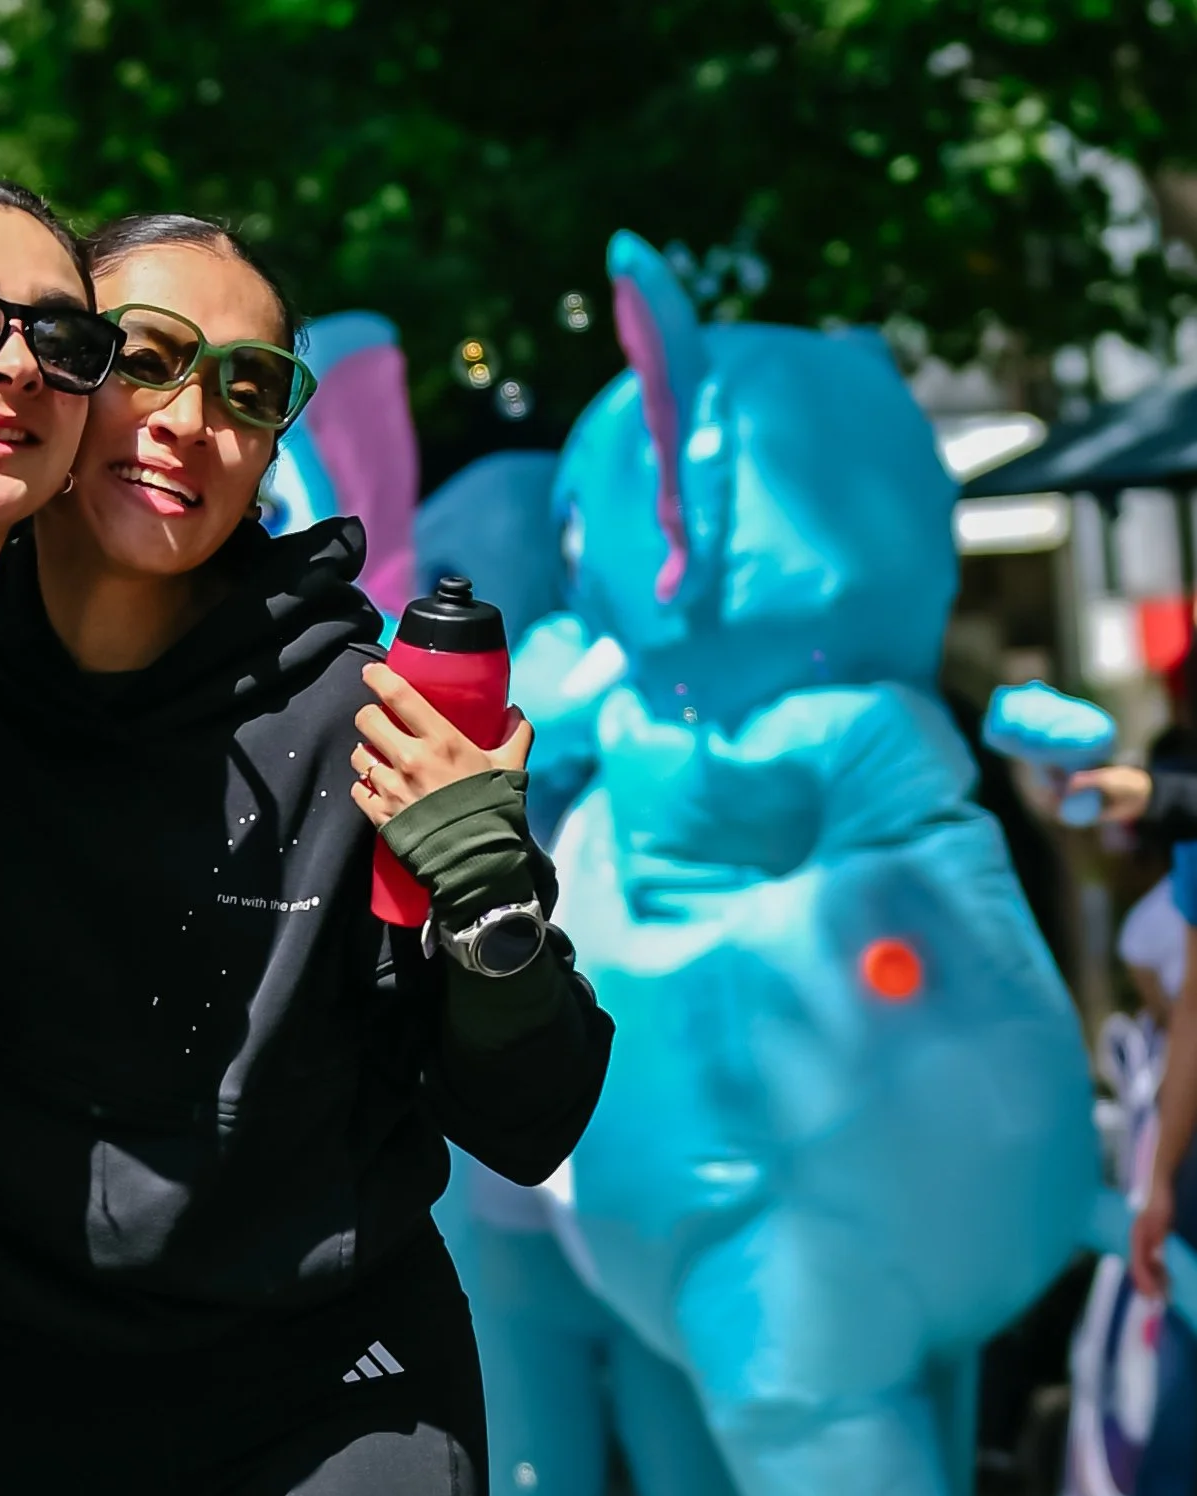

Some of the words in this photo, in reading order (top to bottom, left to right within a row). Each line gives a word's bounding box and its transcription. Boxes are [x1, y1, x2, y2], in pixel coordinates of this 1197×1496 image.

[216, 893, 238, 905] run
[241, 895, 267, 909] with
[269, 899, 289, 912] the
